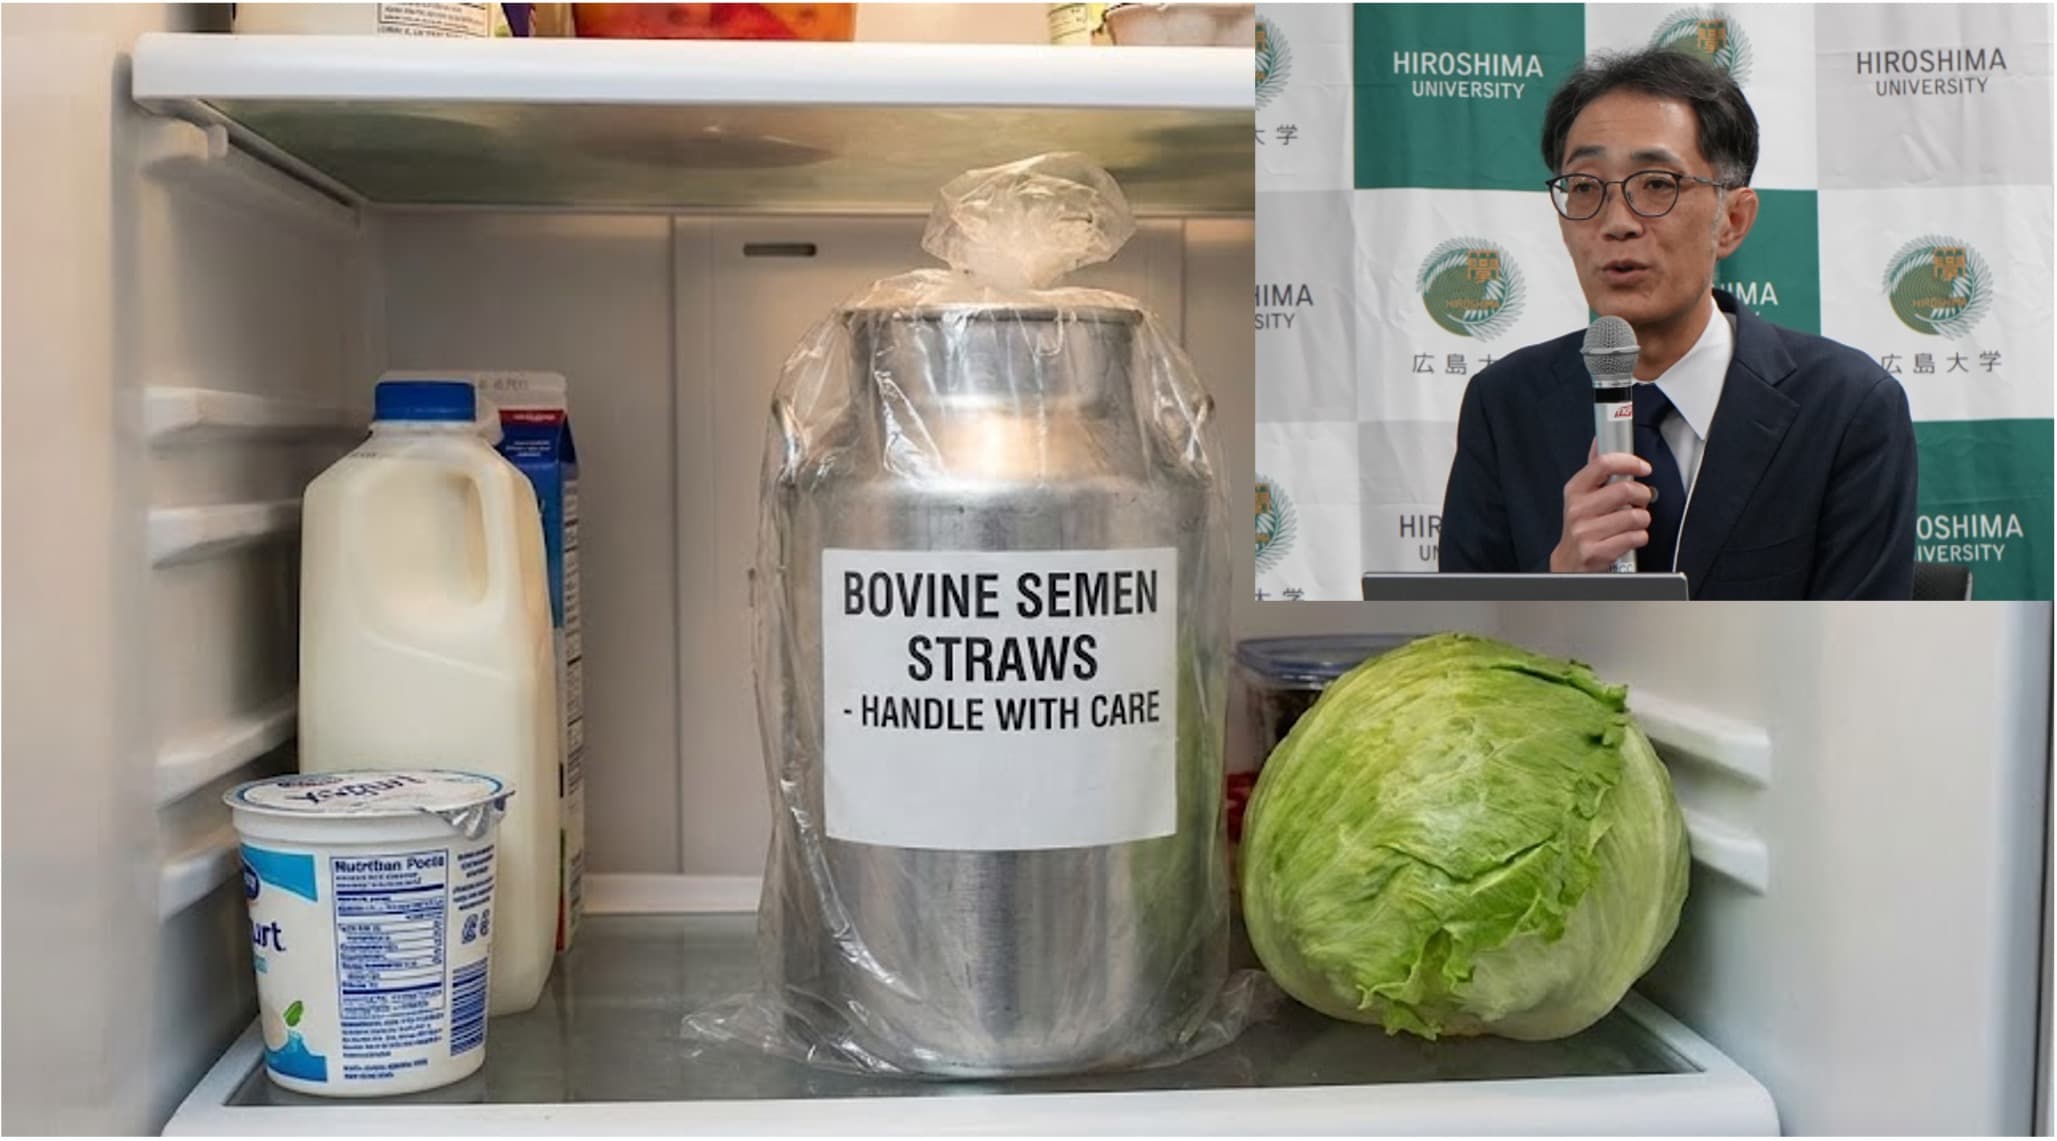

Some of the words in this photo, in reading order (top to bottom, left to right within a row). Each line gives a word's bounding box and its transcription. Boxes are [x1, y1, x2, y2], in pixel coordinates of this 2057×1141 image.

[1393, 51, 1544, 78] HIROSHIMA
[1856, 48, 2007, 75] HIROSHIMA
[1412, 80, 1525, 100] UNIVERSITY
[1876, 77, 1989, 97] UNIVERSITY
[1255, 312, 1296, 330] SITY
[1881, 350, 2002, 374] 広島大学
[1400, 514, 1442, 538] HIR
[1916, 513, 2024, 540] OSHIMA
[1917, 544, 2005, 562] IVERSITY
[844, 571, 1000, 619] BOVINE
[1016, 569, 1158, 619] SEMEN
[907, 634, 1098, 683] STRAWS
[862, 694, 984, 731] HANDLE
[996, 696, 1079, 731] WITH
[1090, 690, 1160, 728] CARE
